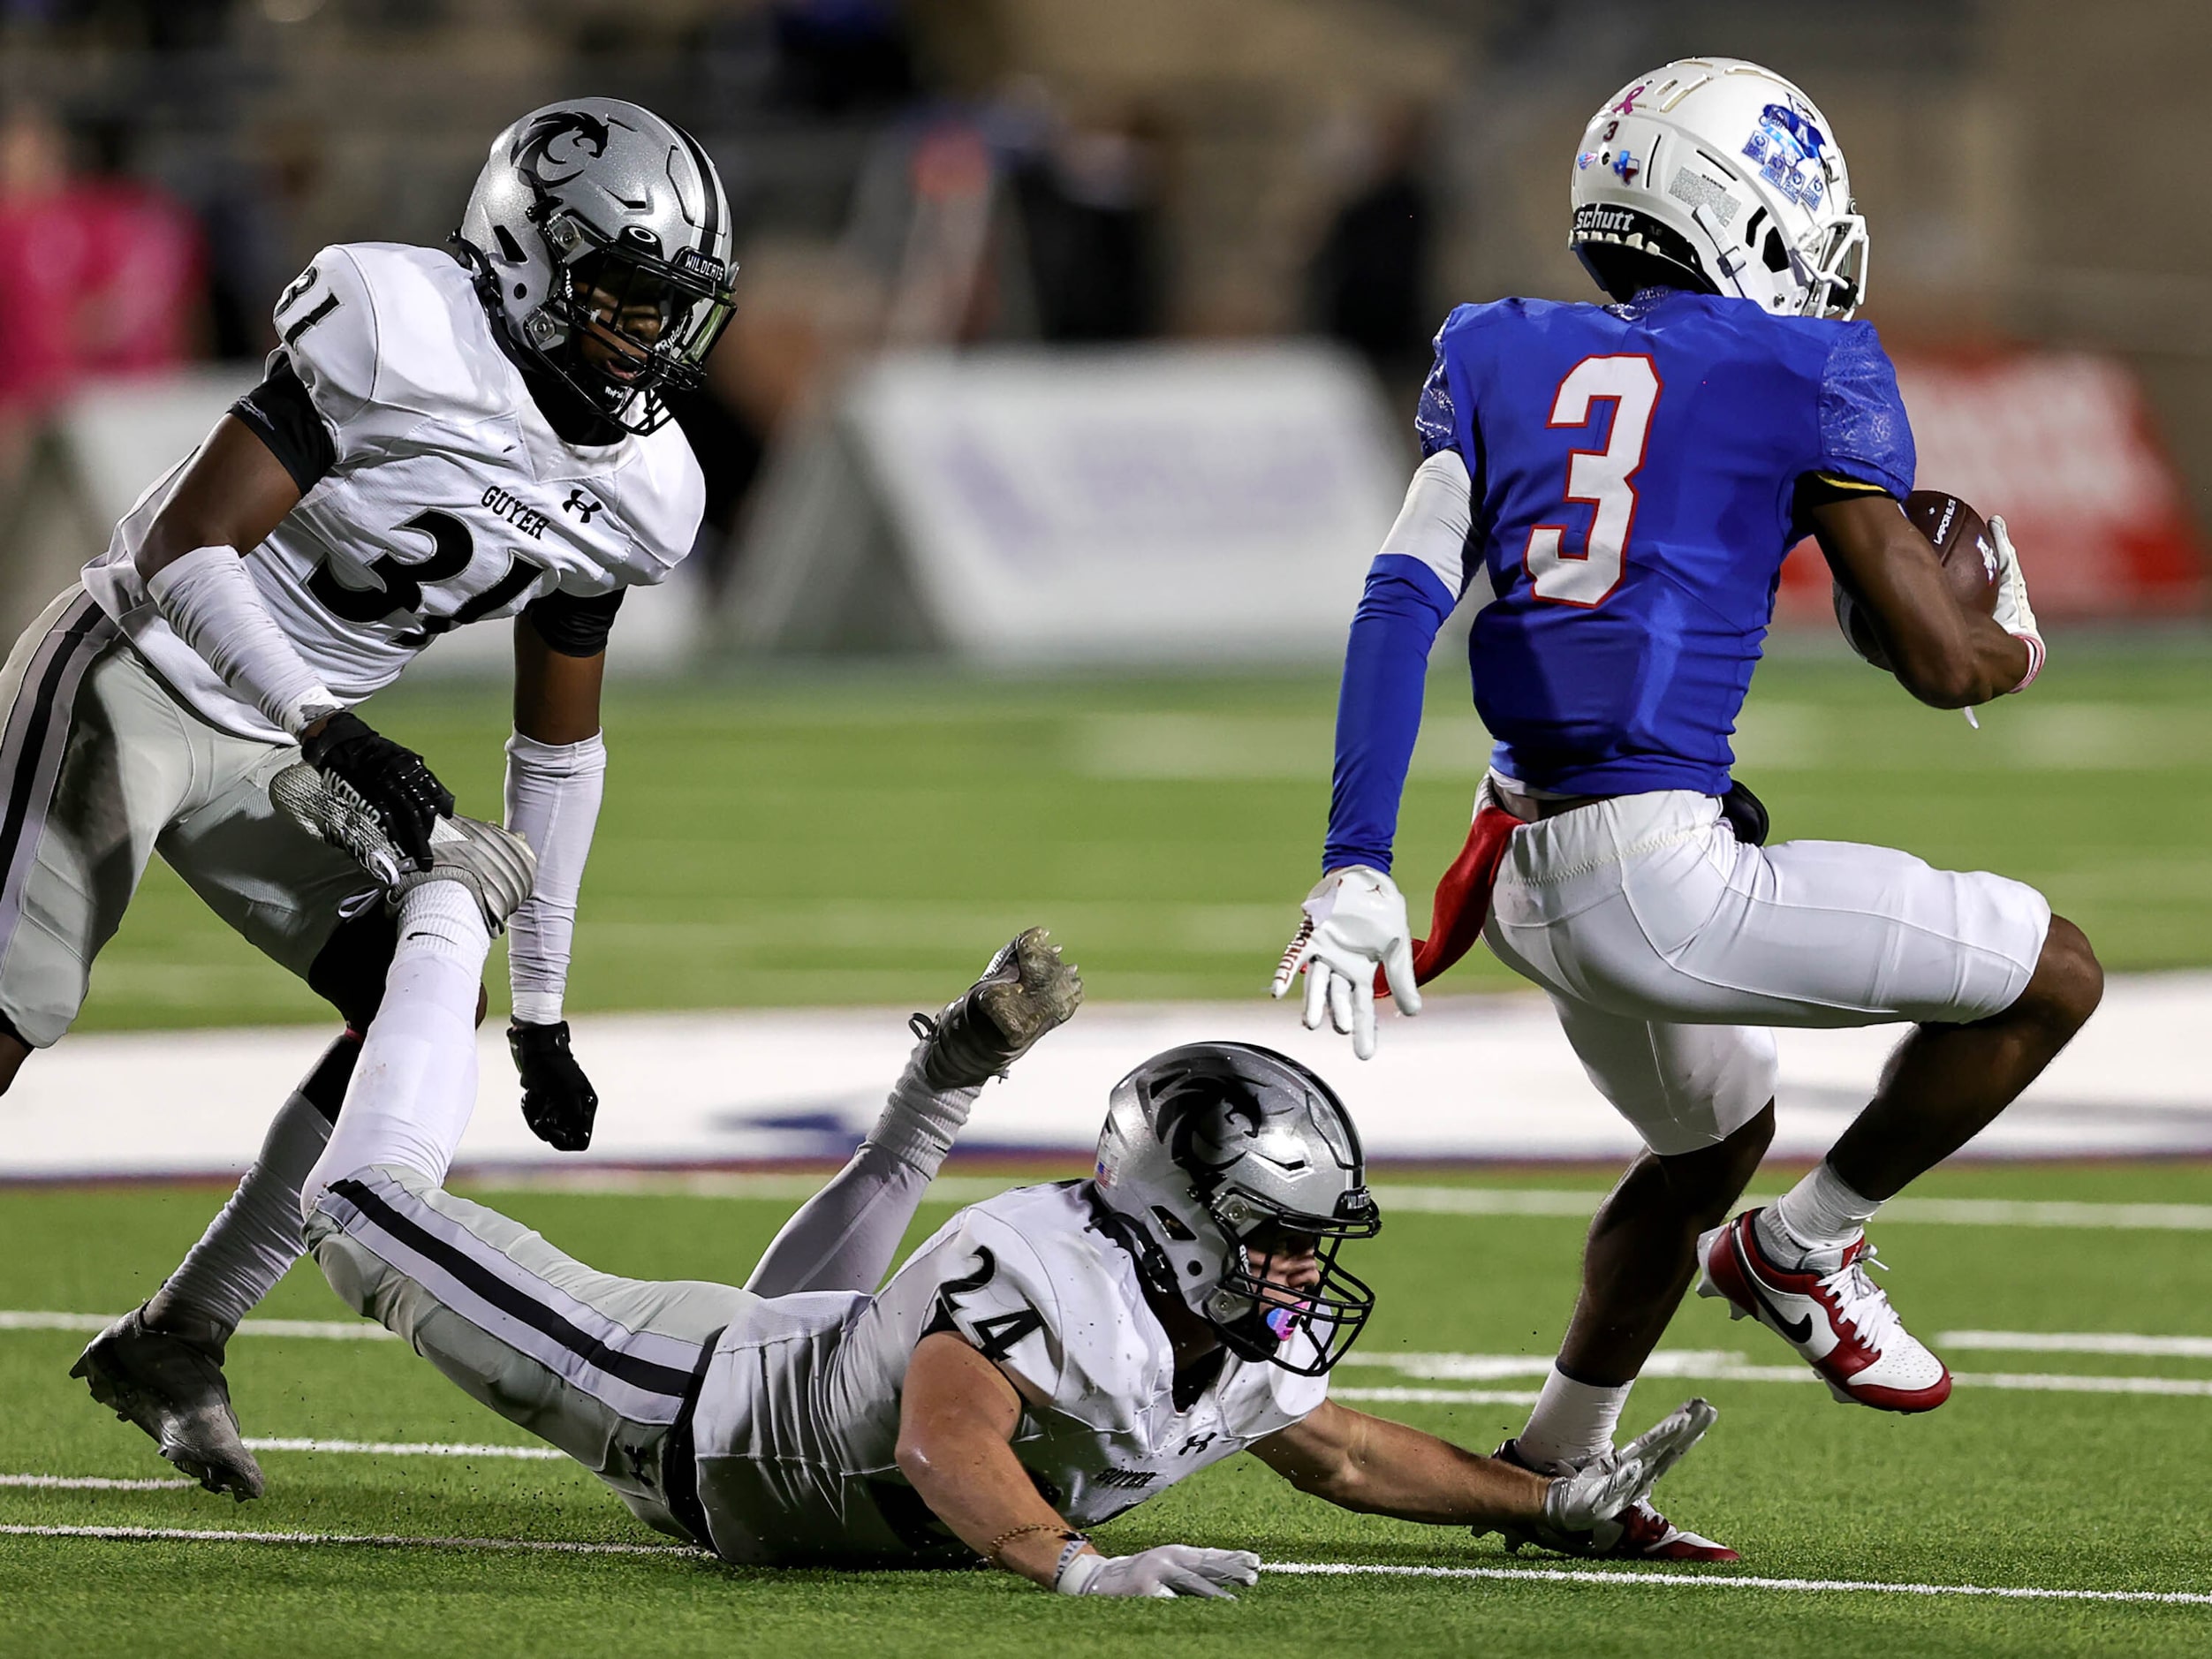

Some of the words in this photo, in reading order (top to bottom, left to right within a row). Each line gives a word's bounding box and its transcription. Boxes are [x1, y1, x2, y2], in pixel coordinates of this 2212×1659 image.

[1602, 120, 1619, 142] 3
[685, 254, 724, 282] WILDCATS
[1522, 352, 1665, 610] 3
[481, 485, 550, 541] GUYER
[299, 506, 545, 648] 31
[939, 1244, 1048, 1364] 24
[1095, 1466, 1157, 1489] GUYER
